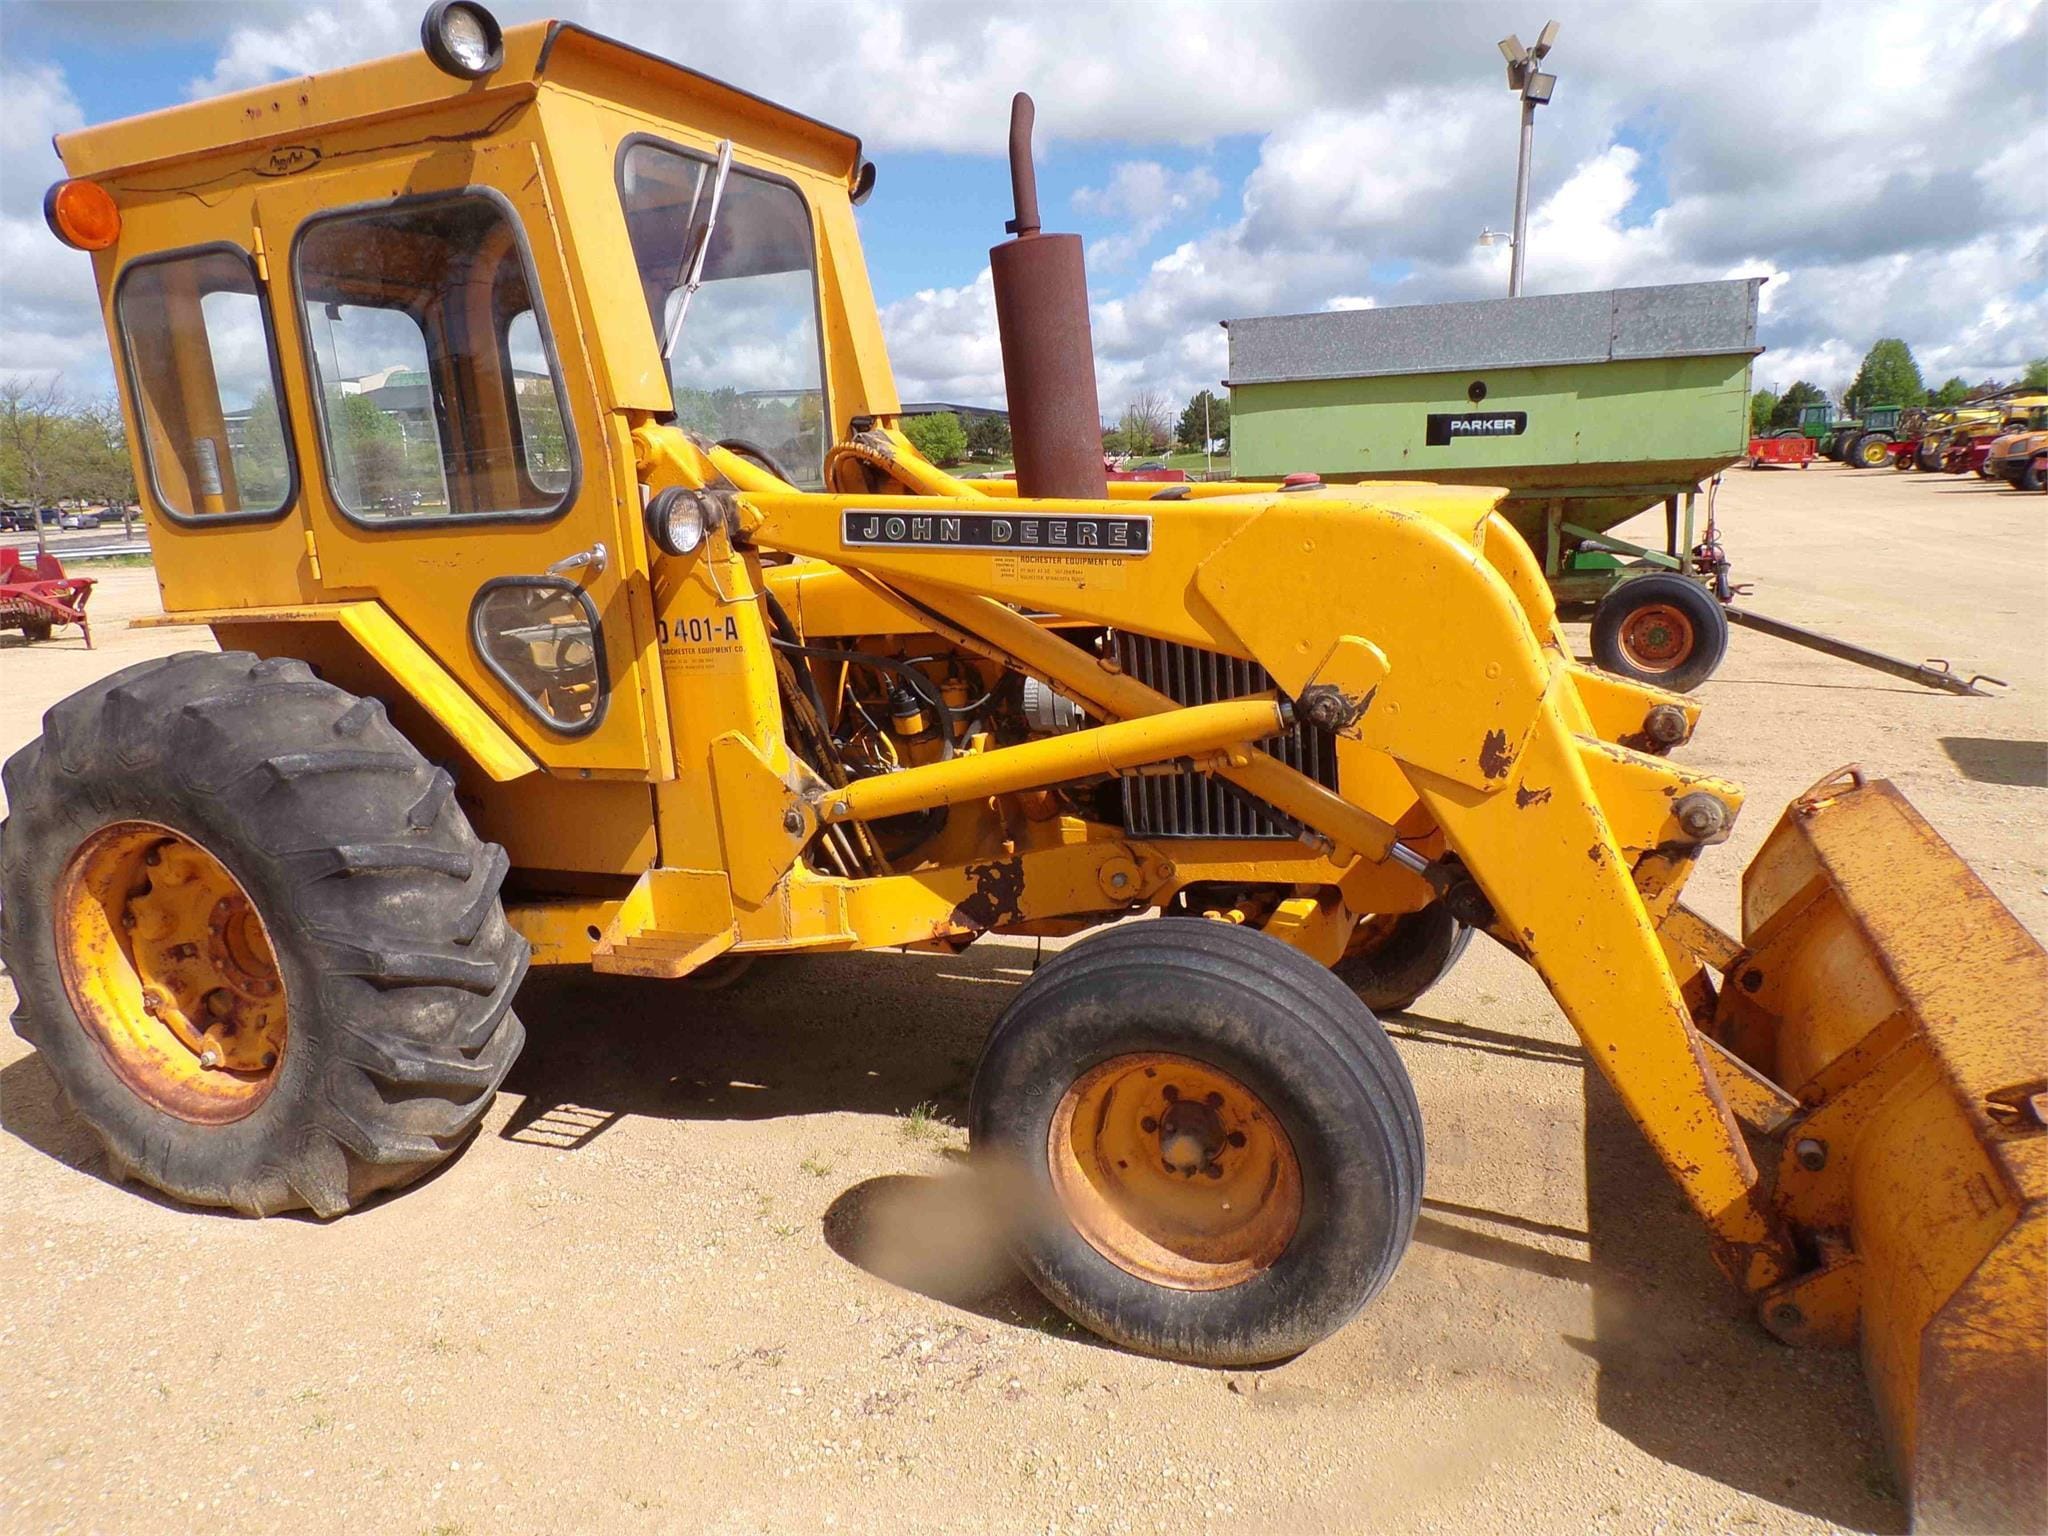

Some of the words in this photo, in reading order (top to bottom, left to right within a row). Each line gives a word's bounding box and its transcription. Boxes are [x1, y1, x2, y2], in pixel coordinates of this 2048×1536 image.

[1450, 419, 1516, 431] PARKER
[863, 516, 961, 541] JOHN
[991, 519, 1129, 547] DEERE
[1020, 555, 1062, 565] ROCHESTER
[1065, 557, 1109, 566] EQUIPMENT
